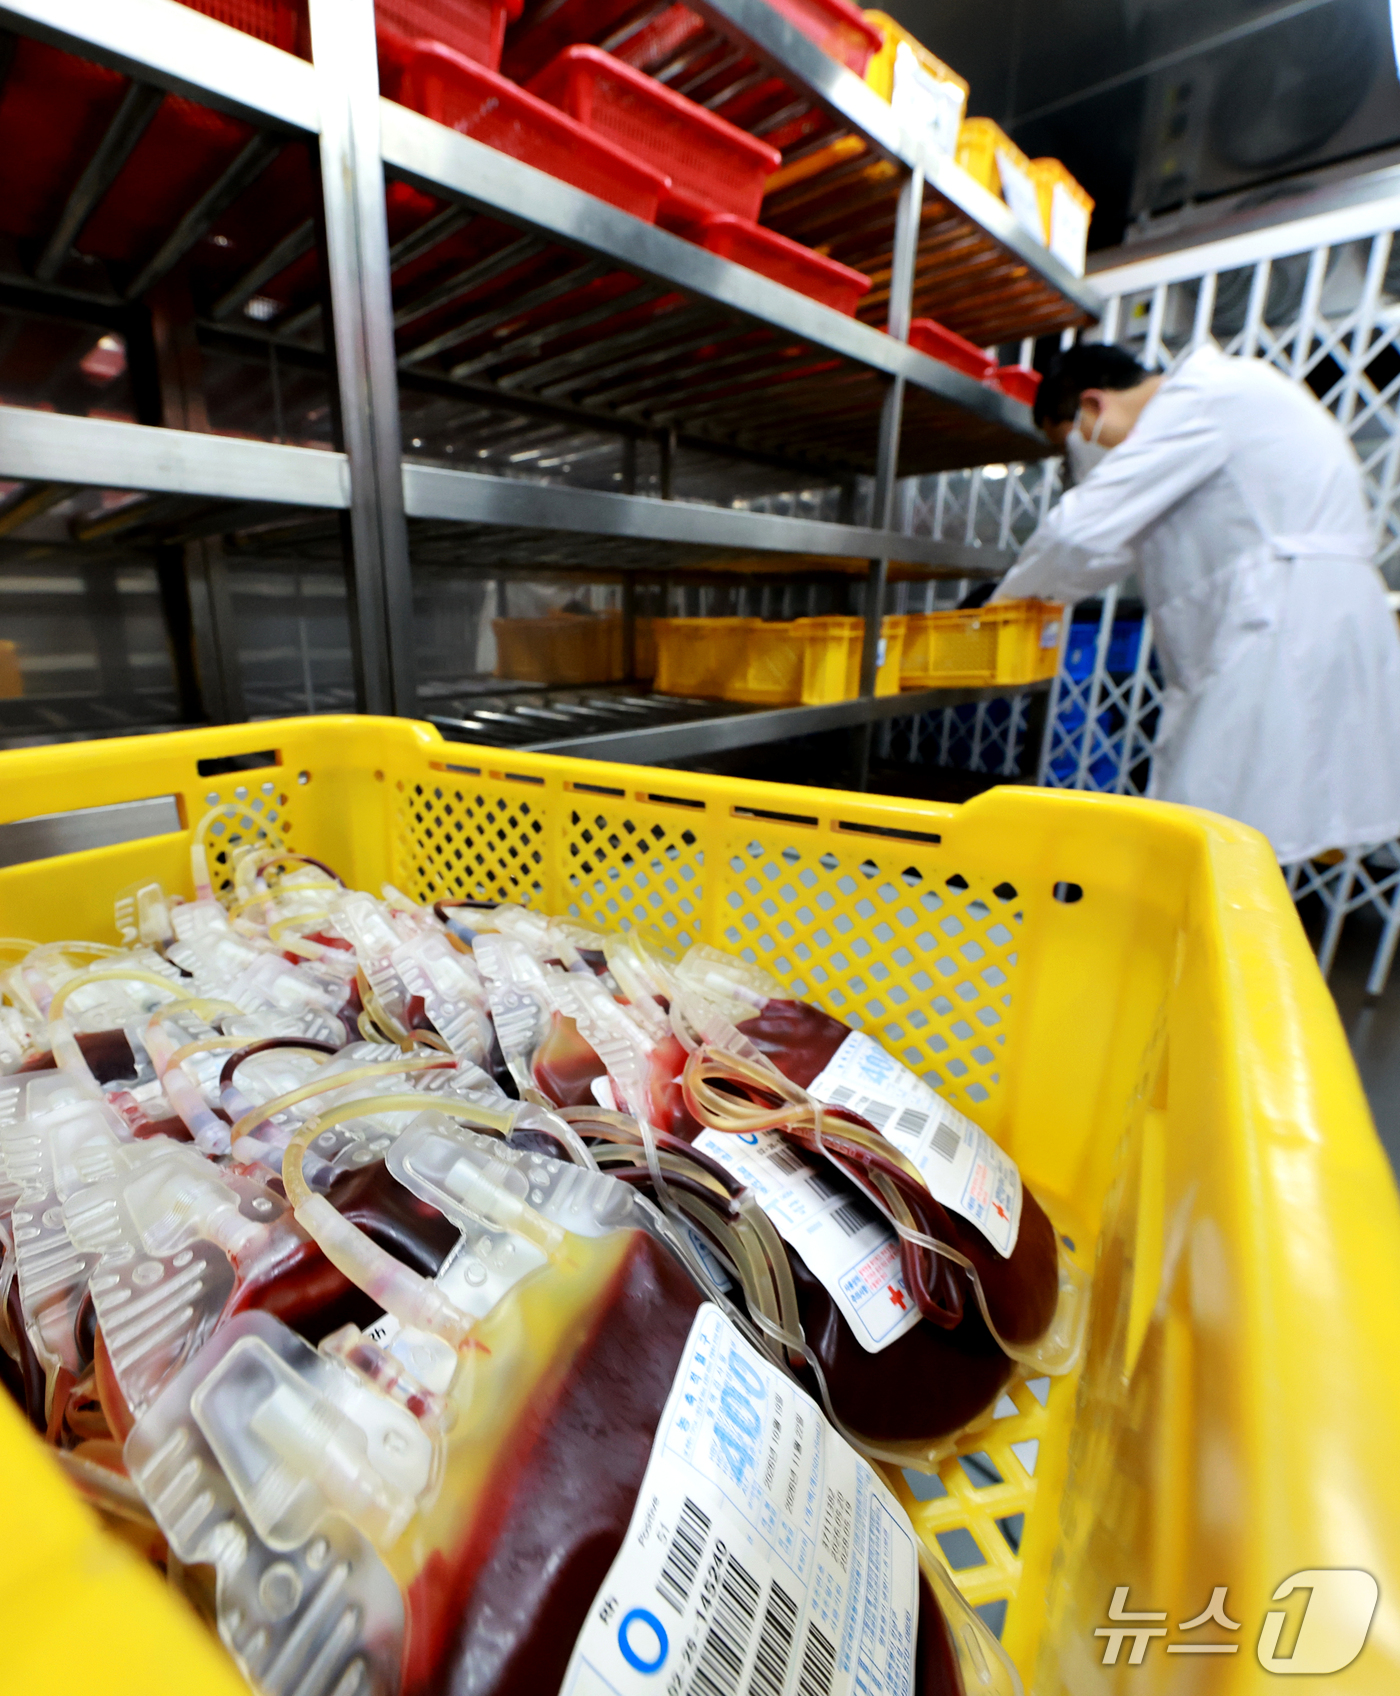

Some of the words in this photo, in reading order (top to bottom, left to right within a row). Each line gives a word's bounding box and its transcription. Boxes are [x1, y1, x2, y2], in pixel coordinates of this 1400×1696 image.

[637, 1495, 660, 1547] Positive
[599, 1595, 619, 1625] Rh
[617, 1607, 669, 1674] O
